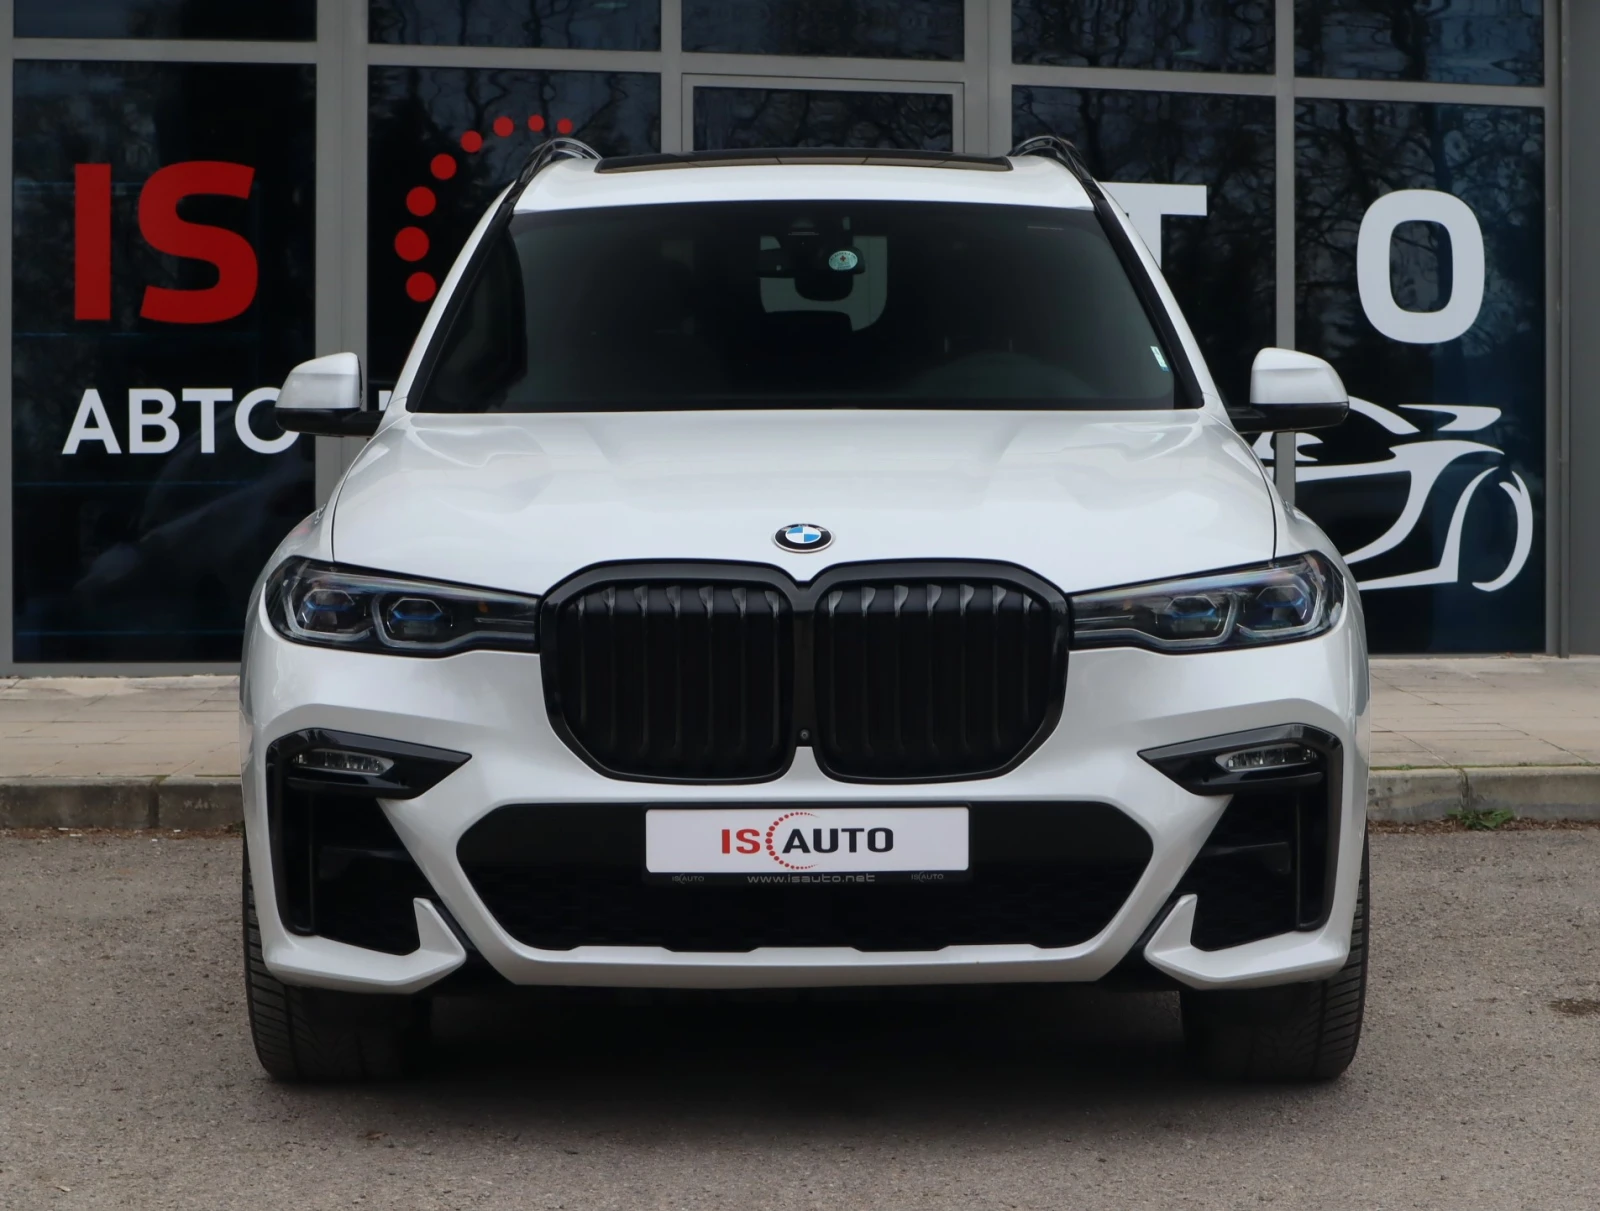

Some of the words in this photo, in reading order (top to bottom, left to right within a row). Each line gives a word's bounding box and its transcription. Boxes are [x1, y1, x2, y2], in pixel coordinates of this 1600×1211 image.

[73, 160, 258, 323] IS
[721, 829, 761, 854] IS
[782, 827, 894, 853] AUTO
[747, 873, 876, 884] www.isauto.net
